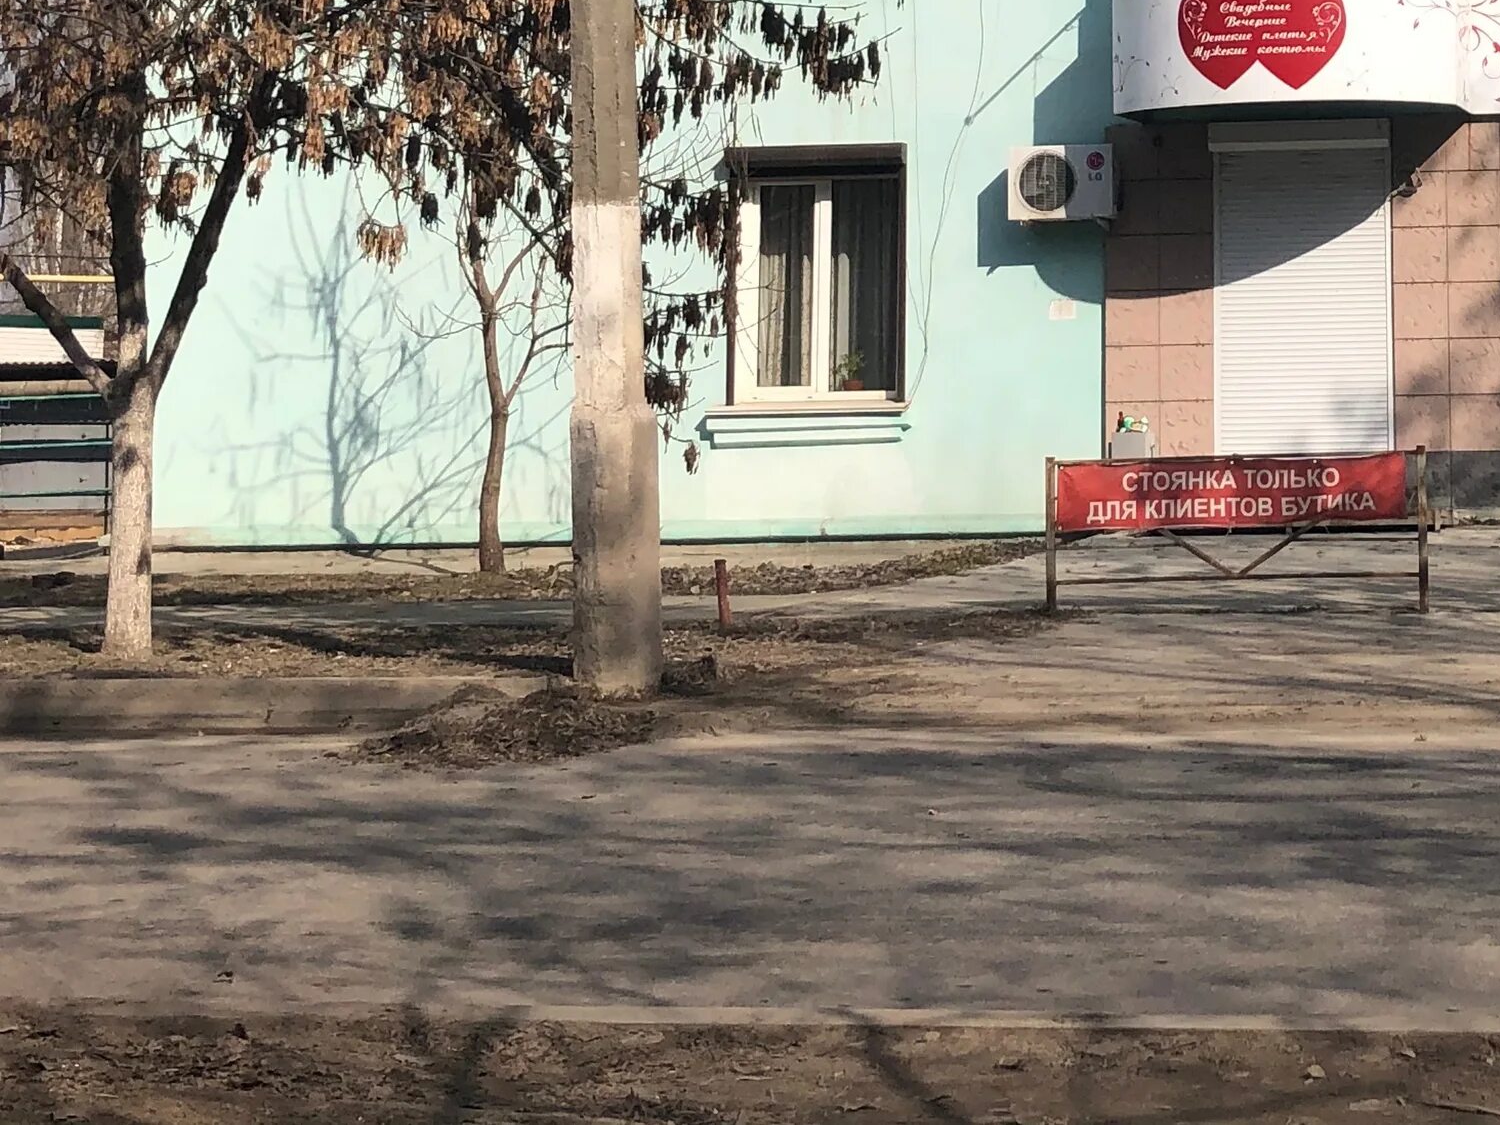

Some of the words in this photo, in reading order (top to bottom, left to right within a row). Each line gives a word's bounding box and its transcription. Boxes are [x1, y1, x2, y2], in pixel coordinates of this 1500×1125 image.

[1224, 15, 1287, 28] Вечерние
[1199, 31, 1253, 43] Детские
[1262, 31, 1318, 42] платья
[1191, 45, 1248, 61] Мужские
[1257, 45, 1327, 54] костюмы
[1121, 469, 1237, 493] СТОЯНКА
[1244, 466, 1341, 490] ТОЛЬКО
[1086, 499, 1138, 525] ДЛЯ
[1144, 496, 1273, 521] КЛИЕНТОВ
[1280, 491, 1377, 517] БУТИКА
